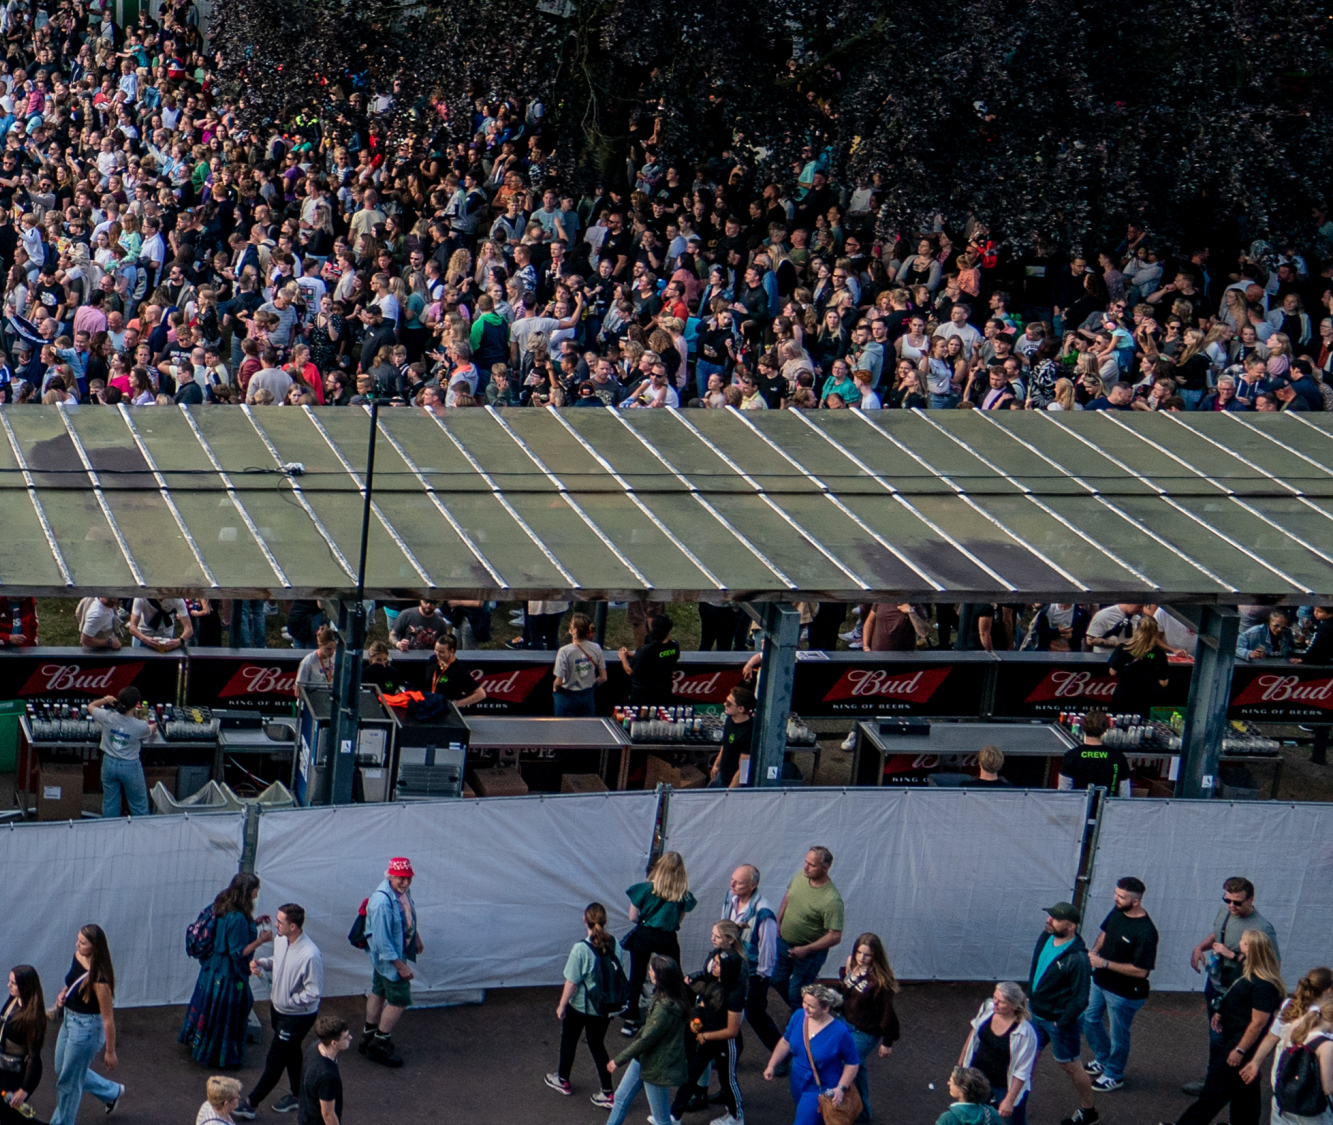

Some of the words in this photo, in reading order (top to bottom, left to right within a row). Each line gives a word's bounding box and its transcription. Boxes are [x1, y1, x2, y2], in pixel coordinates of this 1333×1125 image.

[659, 649, 677, 658] CREW
[41, 664, 116, 690] Bud
[847, 670, 924, 695] Bud
[1258, 675, 1333, 701] Bud
[1081, 751, 1108, 759] CREW
